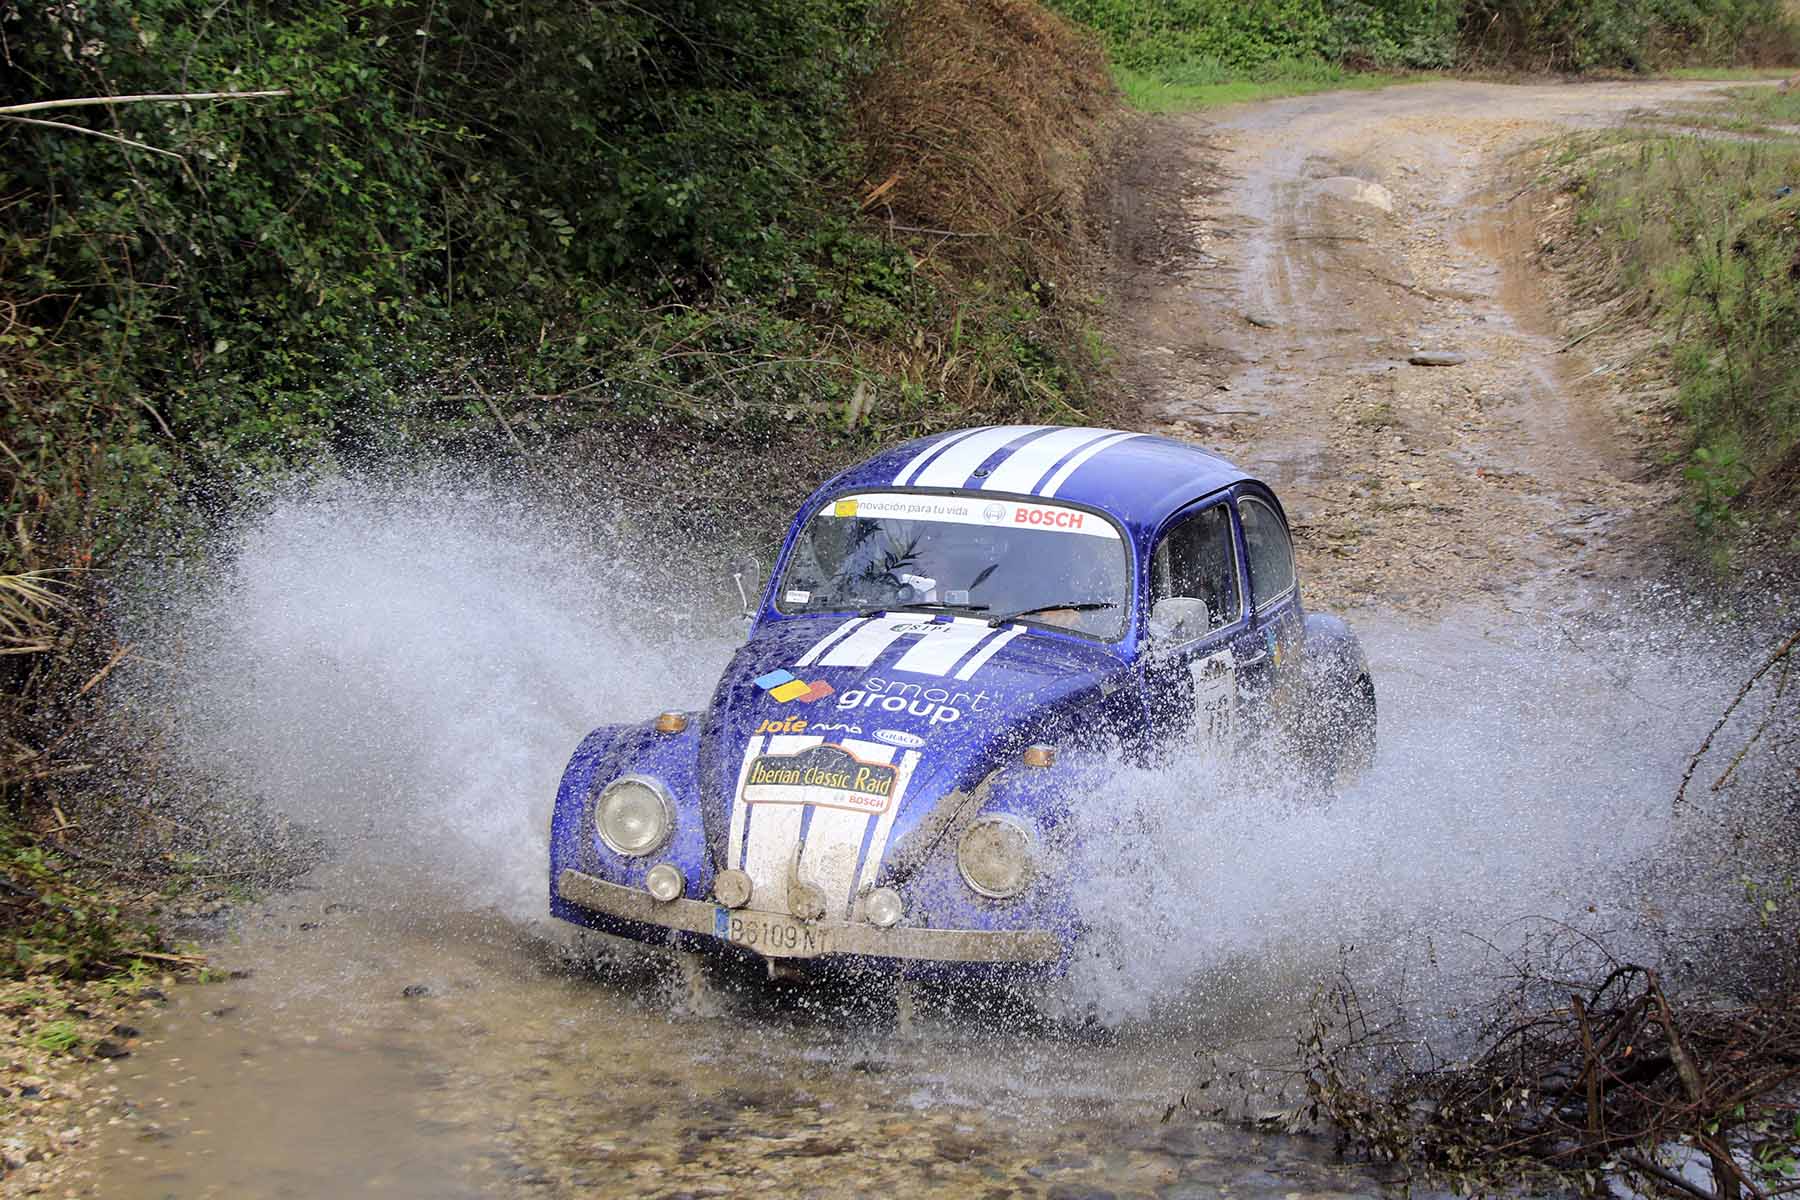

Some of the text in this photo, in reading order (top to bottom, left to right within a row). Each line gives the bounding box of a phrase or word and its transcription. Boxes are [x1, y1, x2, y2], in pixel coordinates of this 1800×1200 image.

[907, 504, 932, 514] para
[933, 504, 945, 514] tu
[946, 504, 969, 516] vida
[1014, 507, 1084, 529] BOSCH
[865, 677, 990, 712] smart
[836, 689, 961, 725] group
[811, 723, 863, 734] nuna
[751, 760, 892, 795] Iberian Classic Raid
[849, 794, 885, 808] BOSCH
